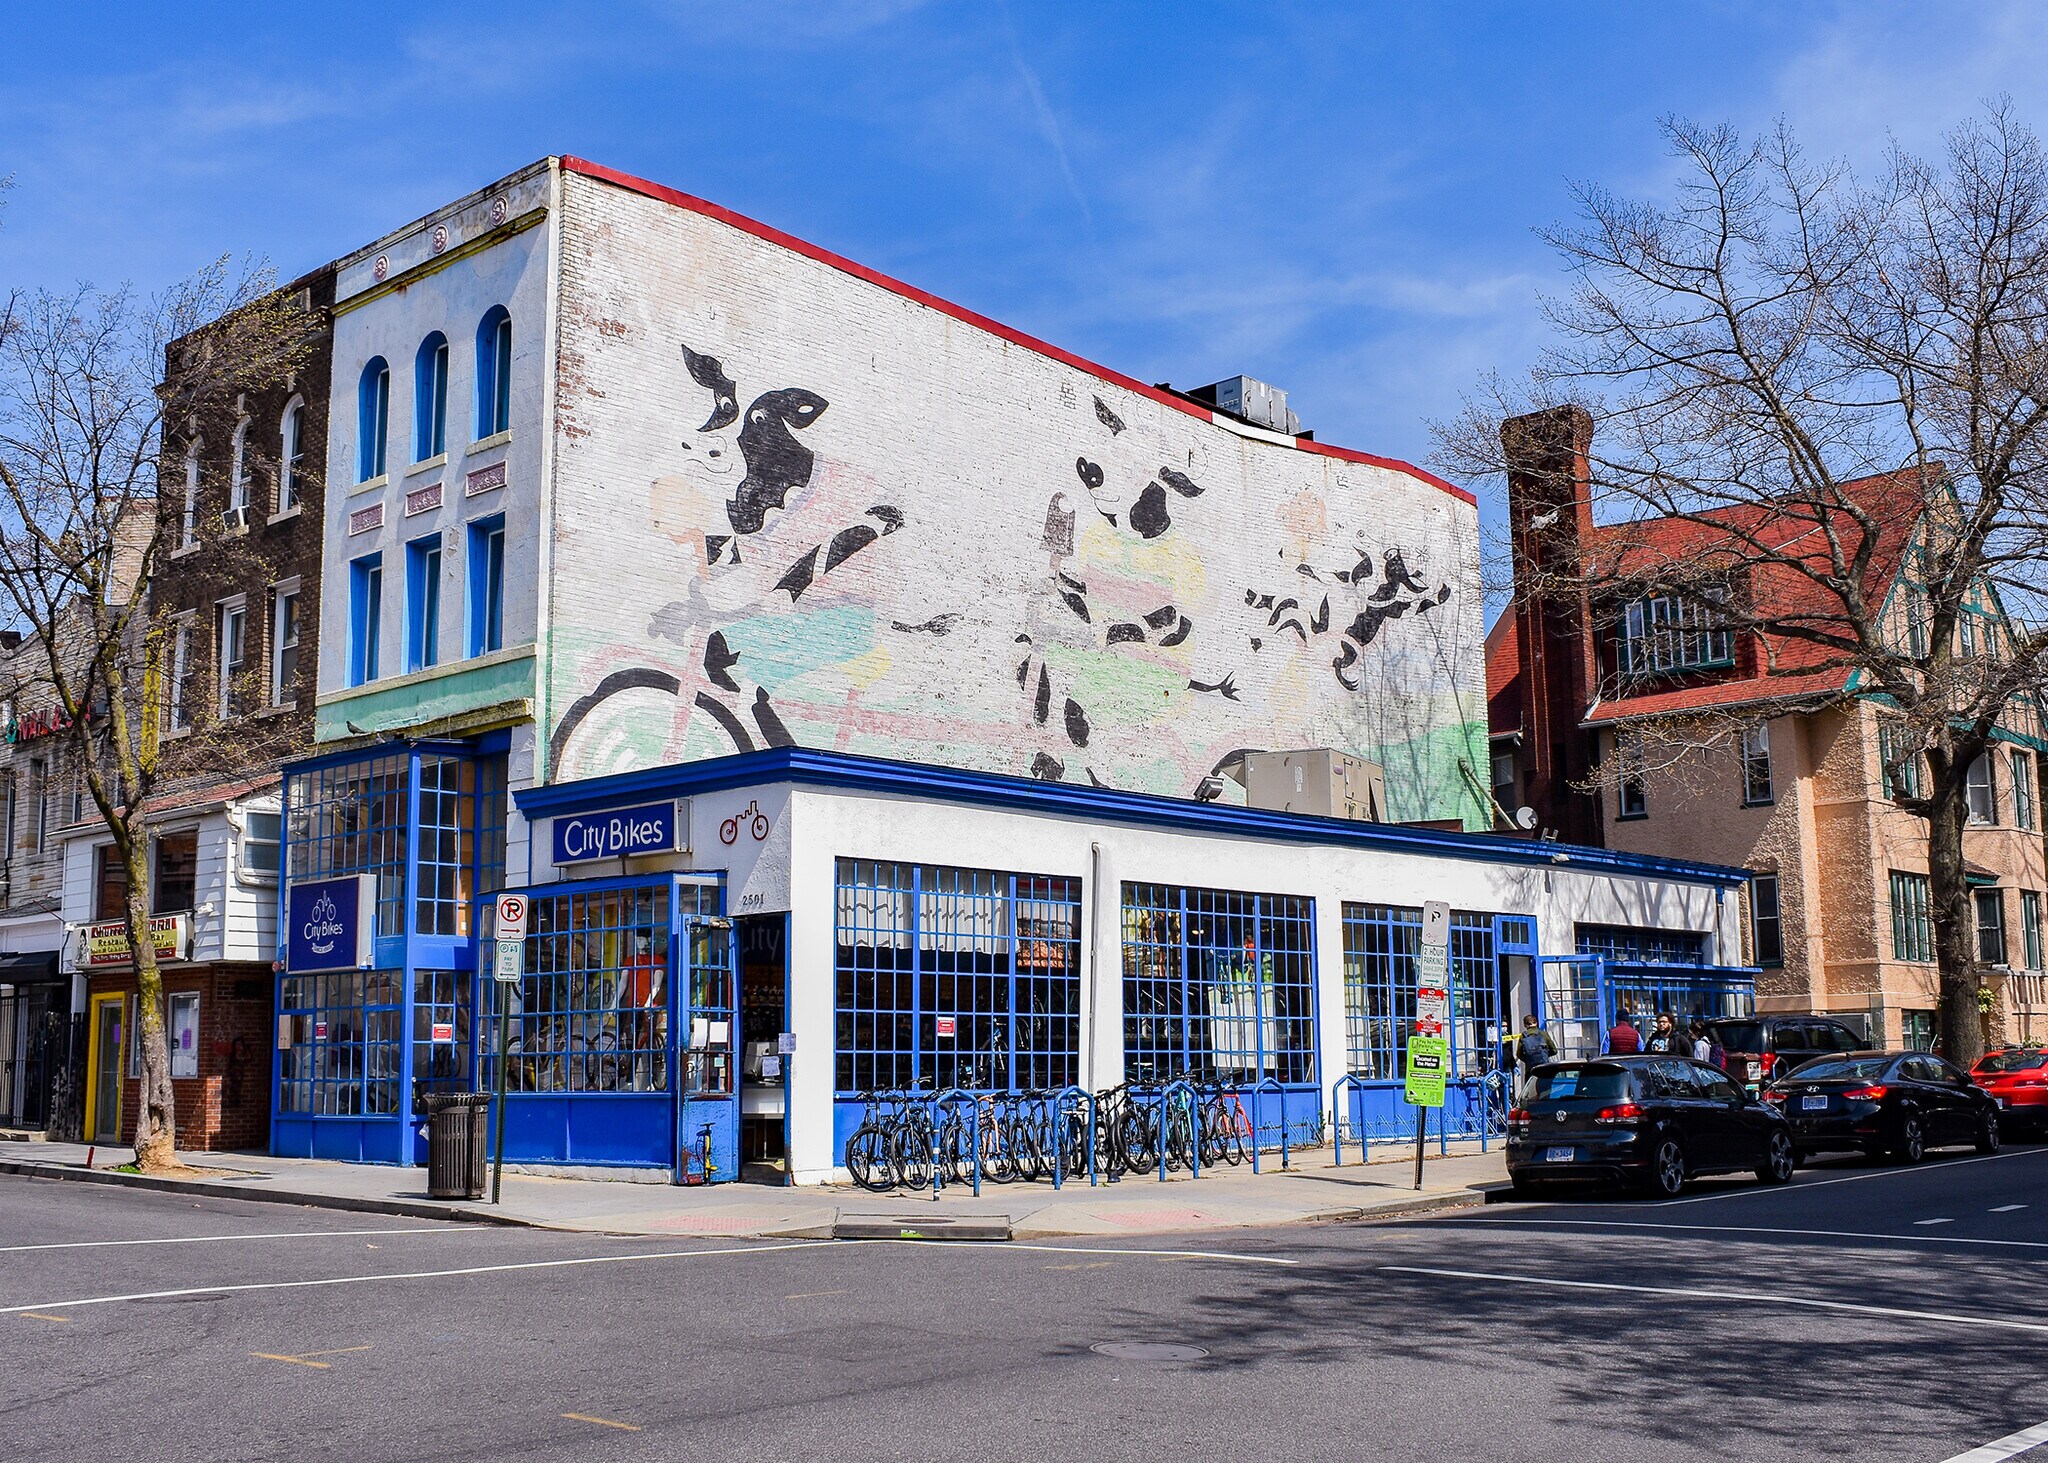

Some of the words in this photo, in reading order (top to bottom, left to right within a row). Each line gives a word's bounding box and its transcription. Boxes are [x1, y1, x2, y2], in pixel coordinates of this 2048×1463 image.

[564, 820, 606, 858] City
[609, 818, 663, 850] Bikes
[742, 893, 765, 906] 2501
[304, 922, 321, 941] City
[322, 921, 343, 936] Bikes
